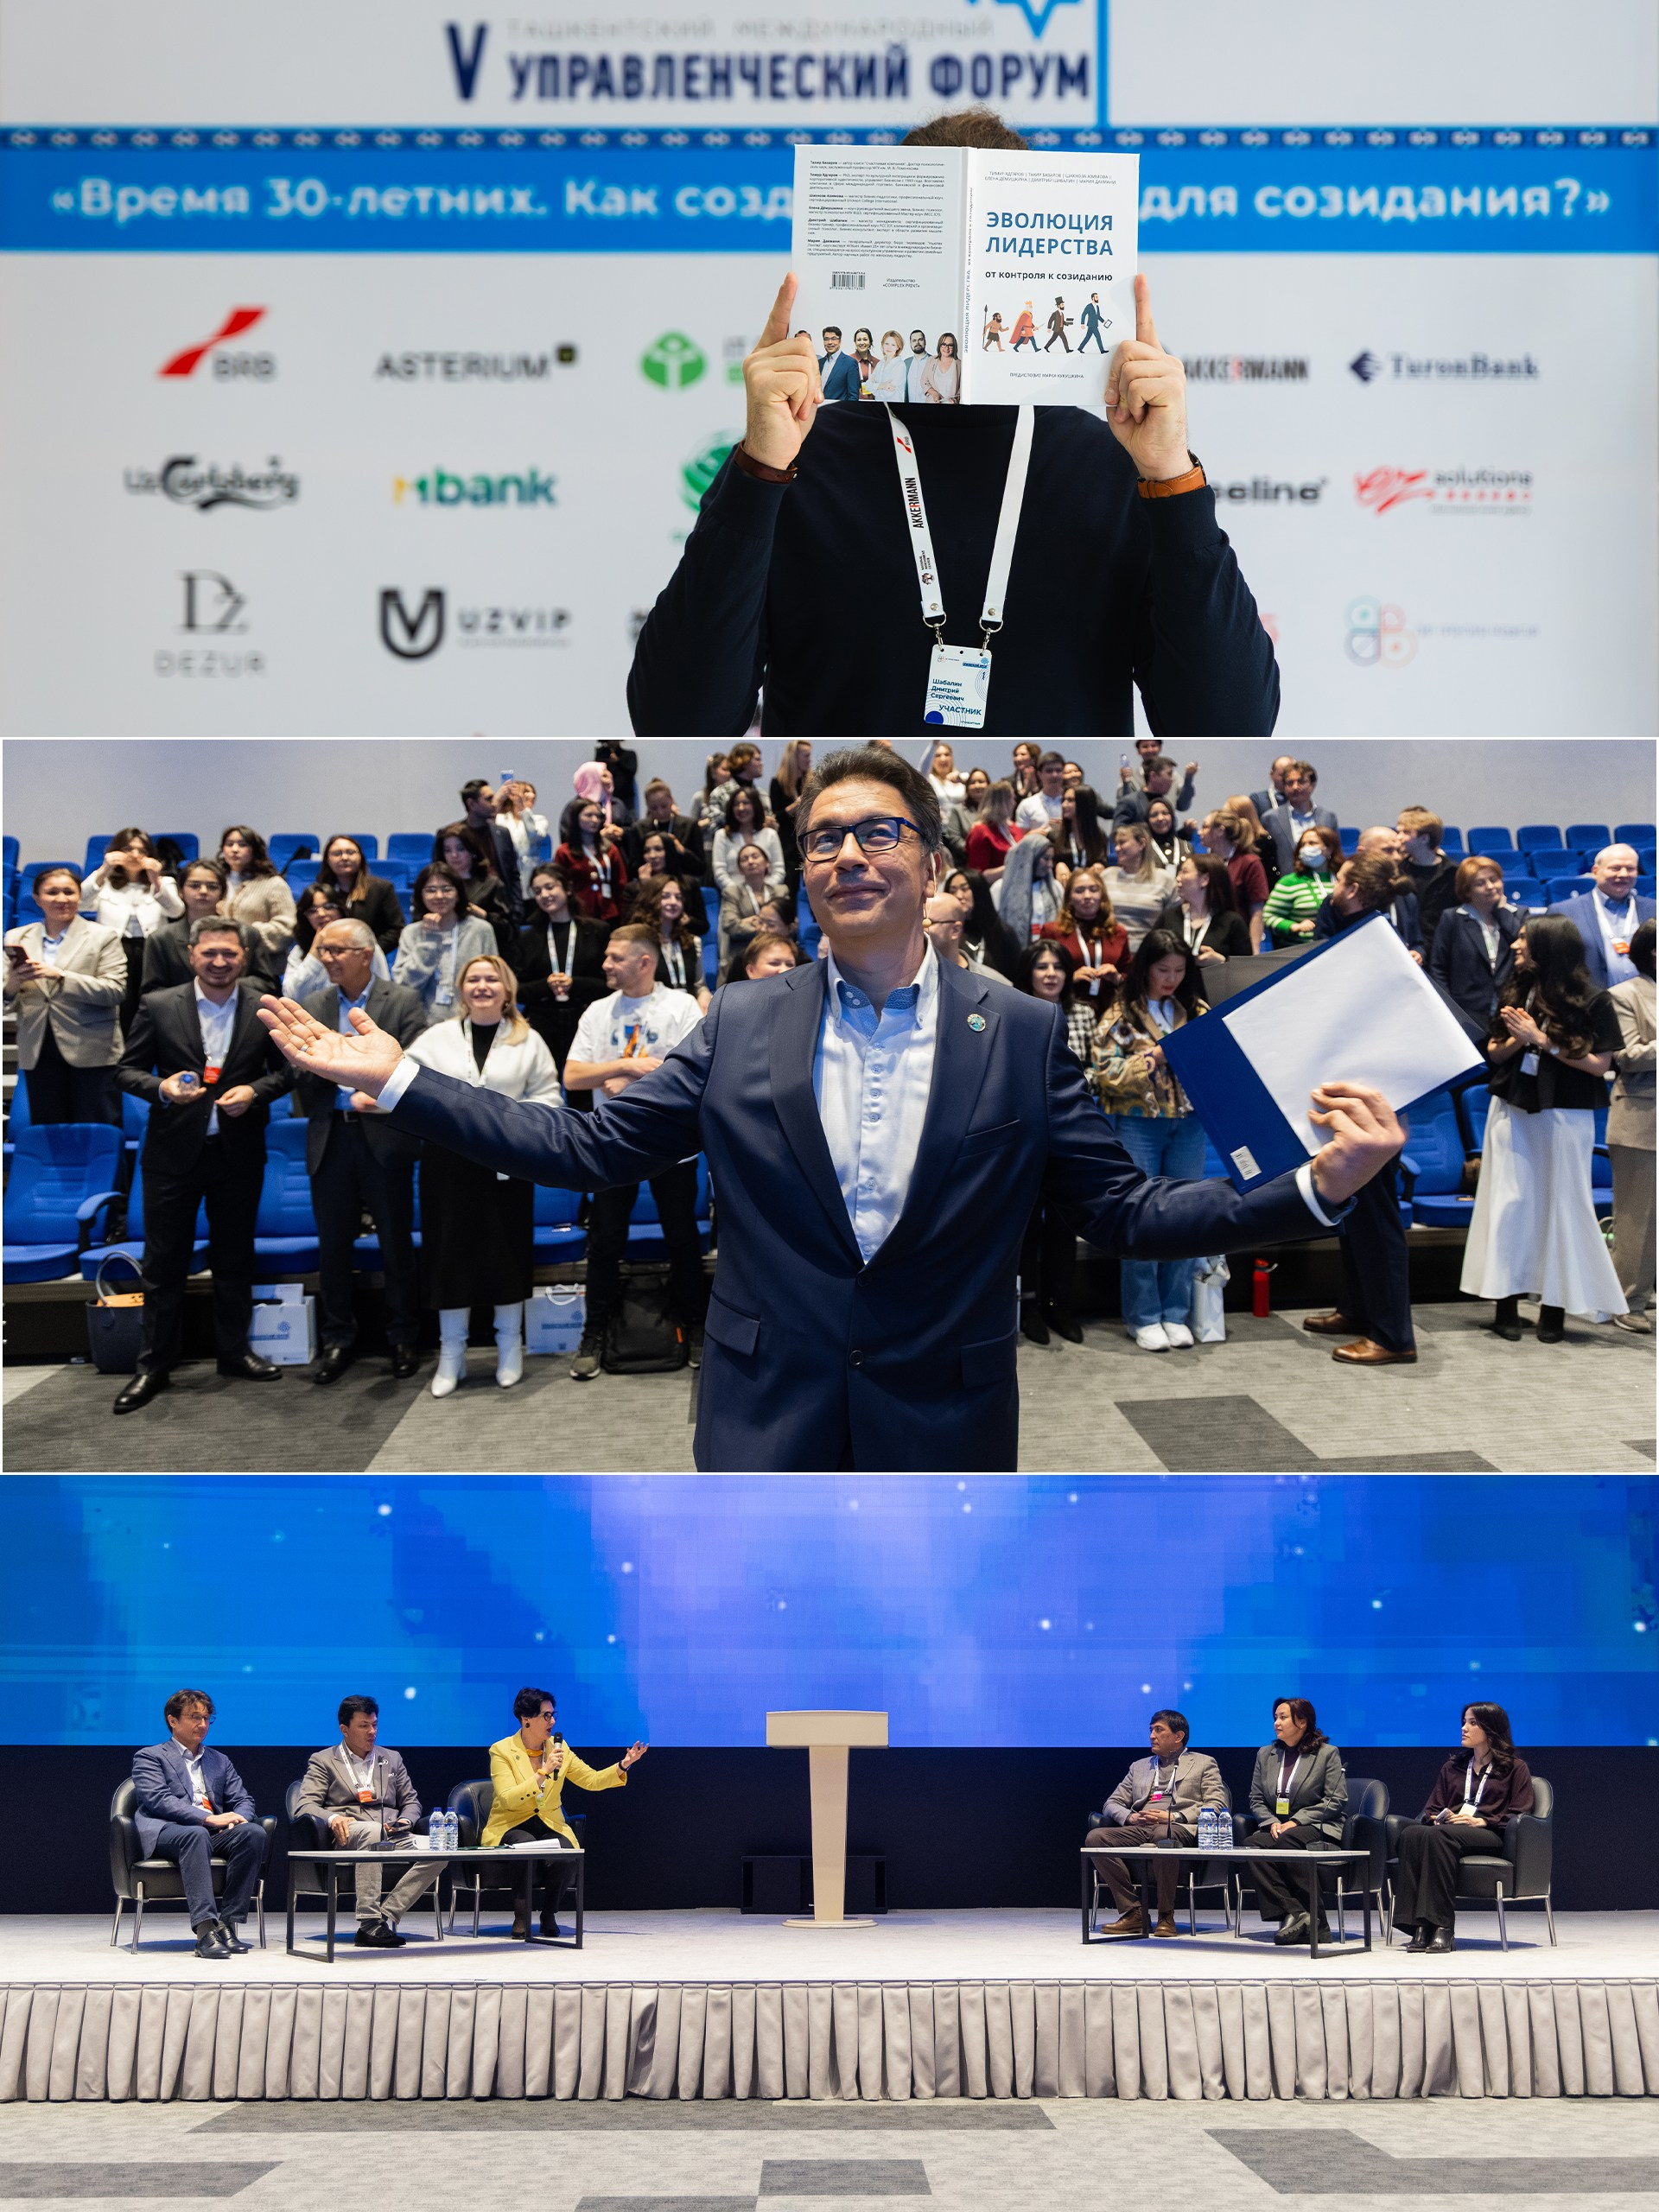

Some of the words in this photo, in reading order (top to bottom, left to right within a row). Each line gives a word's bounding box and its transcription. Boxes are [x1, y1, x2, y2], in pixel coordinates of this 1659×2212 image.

[508, 42, 910, 102] УПРАВЛЕНЧЕСКИЙ
[928, 53, 1089, 102] ФОРУМ
[53, 177, 250, 226] «Время
[265, 177, 547, 218] 30-летних.
[566, 179, 658, 217] Как
[1139, 185, 1238, 222] для
[1254, 177, 1611, 222] созидания?»
[987, 212, 1113, 234] ЭВОЛЮЦИЯ
[985, 237, 1113, 257] ЛИДЕРСТВА
[999, 271, 1046, 282] контроля
[1056, 273, 1113, 282] созиданию
[375, 353, 550, 380] ASTERIUM
[1390, 352, 1540, 382] TuronBank
[1433, 467, 1533, 487] solutions
[905, 477, 925, 529] AKKERMANN
[1213, 476, 1322, 505] eline
[458, 607, 572, 633] UZVIP
[932, 678, 963, 688] Шабалин
[931, 693, 964, 702] Сергеевич
[938, 704, 982, 715] УЧАСТНИК
